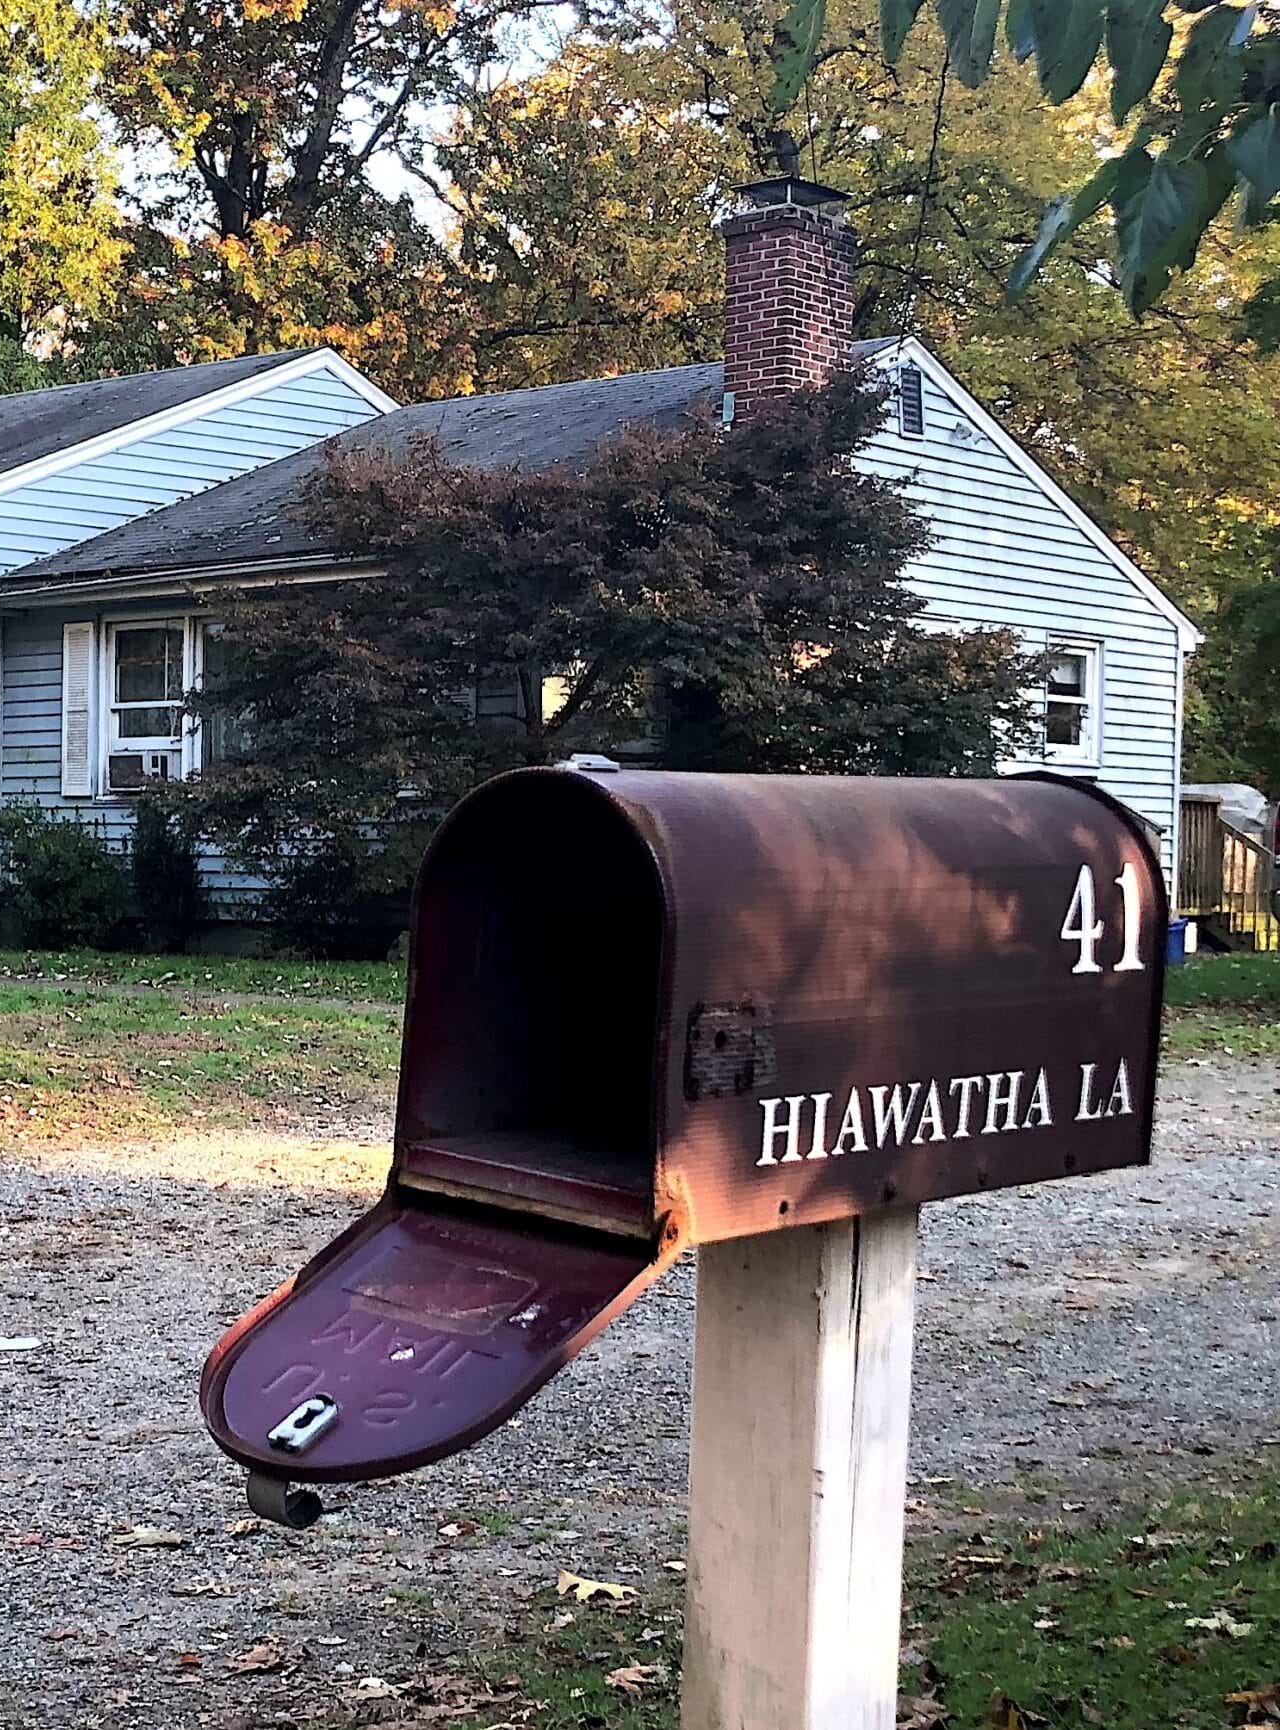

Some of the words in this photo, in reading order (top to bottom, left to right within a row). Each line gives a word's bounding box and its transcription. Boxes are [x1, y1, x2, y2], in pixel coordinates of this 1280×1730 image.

[1060, 862, 1146, 974] 41
[756, 1066, 1053, 1167] HIAWATHA
[1074, 1057, 1133, 1121] LA
